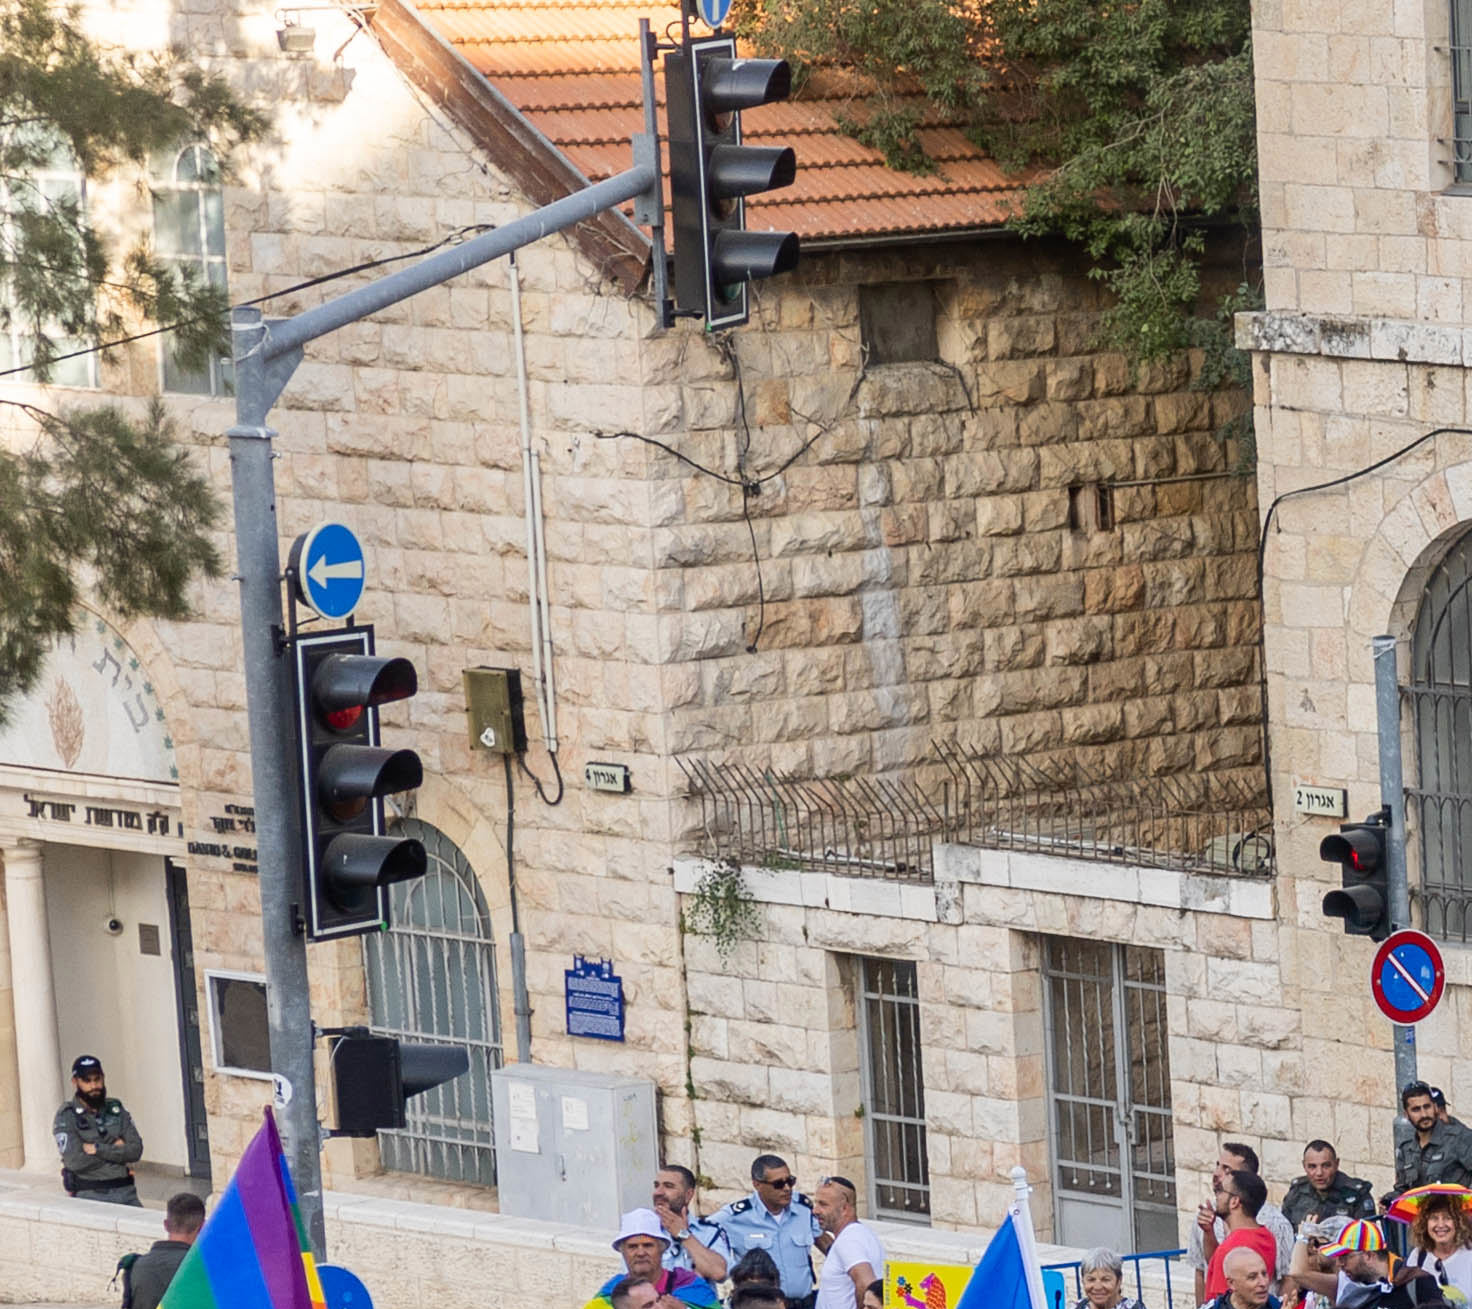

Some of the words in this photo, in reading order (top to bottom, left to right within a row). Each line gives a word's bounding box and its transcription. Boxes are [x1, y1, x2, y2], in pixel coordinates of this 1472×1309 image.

[592, 770, 618, 787] אגרון
[1296, 790, 1303, 806] 2
[1305, 792, 1336, 810] אגרון
[22, 793, 77, 823] ישראל
